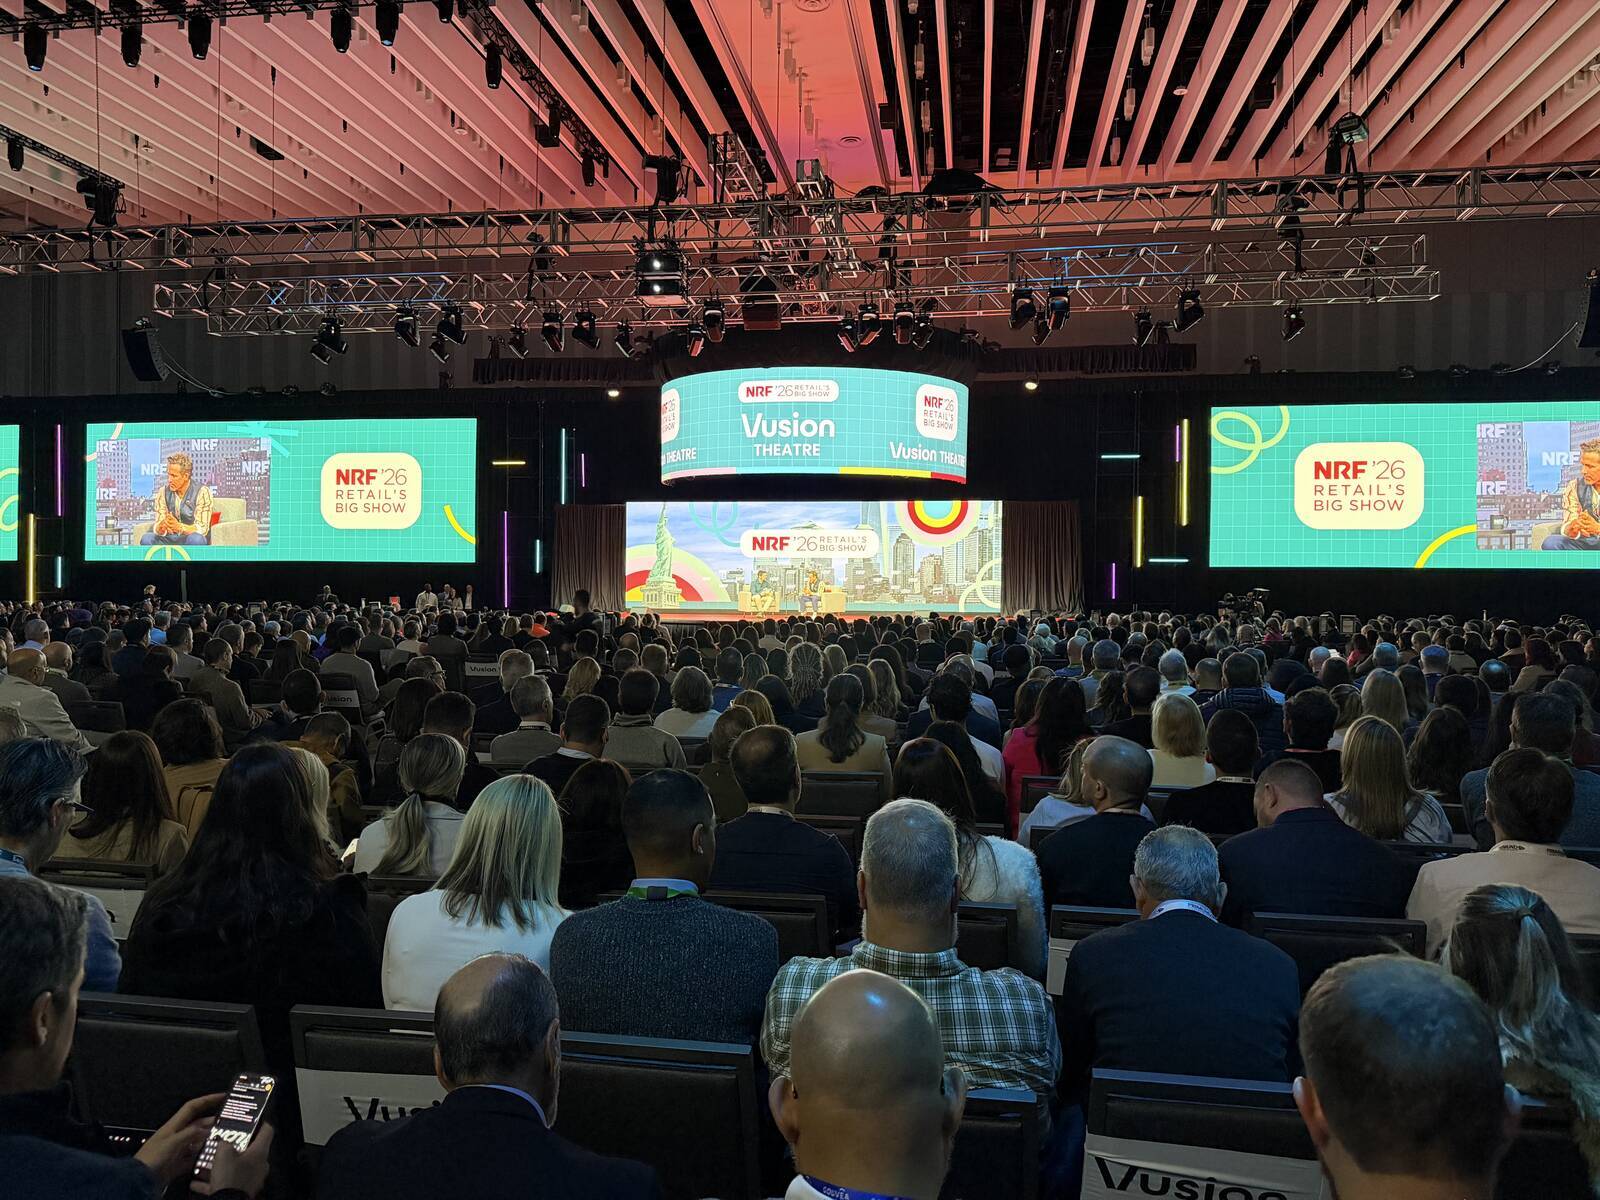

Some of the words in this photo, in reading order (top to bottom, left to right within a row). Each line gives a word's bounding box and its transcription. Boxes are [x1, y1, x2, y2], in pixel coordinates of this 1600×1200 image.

[746, 386, 773, 398] NRF
[776, 385, 793, 397] '26
[924, 395, 944, 409] NRF
[923, 409, 954, 422] RETAIL'S
[741, 411, 836, 438] Vusion
[923, 419, 935, 428] BIG
[936, 421, 954, 430] SHOW
[191, 439, 219, 451] NRF
[753, 443, 821, 457] THEATRE
[889, 441, 937, 462] Vusion
[666, 447, 697, 464] THEATRE
[241, 460, 270, 474] NRF
[1313, 461, 1368, 480] NRF
[1372, 460, 1406, 480] '26
[336, 469, 378, 485] NRF
[381, 468, 407, 485] '26
[336, 489, 407, 500] RETAIL'S
[1313, 484, 1405, 496] RETAIL'S
[336, 503, 358, 513] BIG
[363, 503, 406, 513] SHOW
[1313, 499, 1343, 511] BIG
[1349, 499, 1404, 511] SHOW
[752, 536, 791, 551] NRF
[793, 535, 818, 552] '26
[820, 535, 867, 544] RETAIL'S
[820, 544, 835, 552] BIG
[838, 544, 866, 552] SHOW
[470, 665, 497, 673] Vusion
